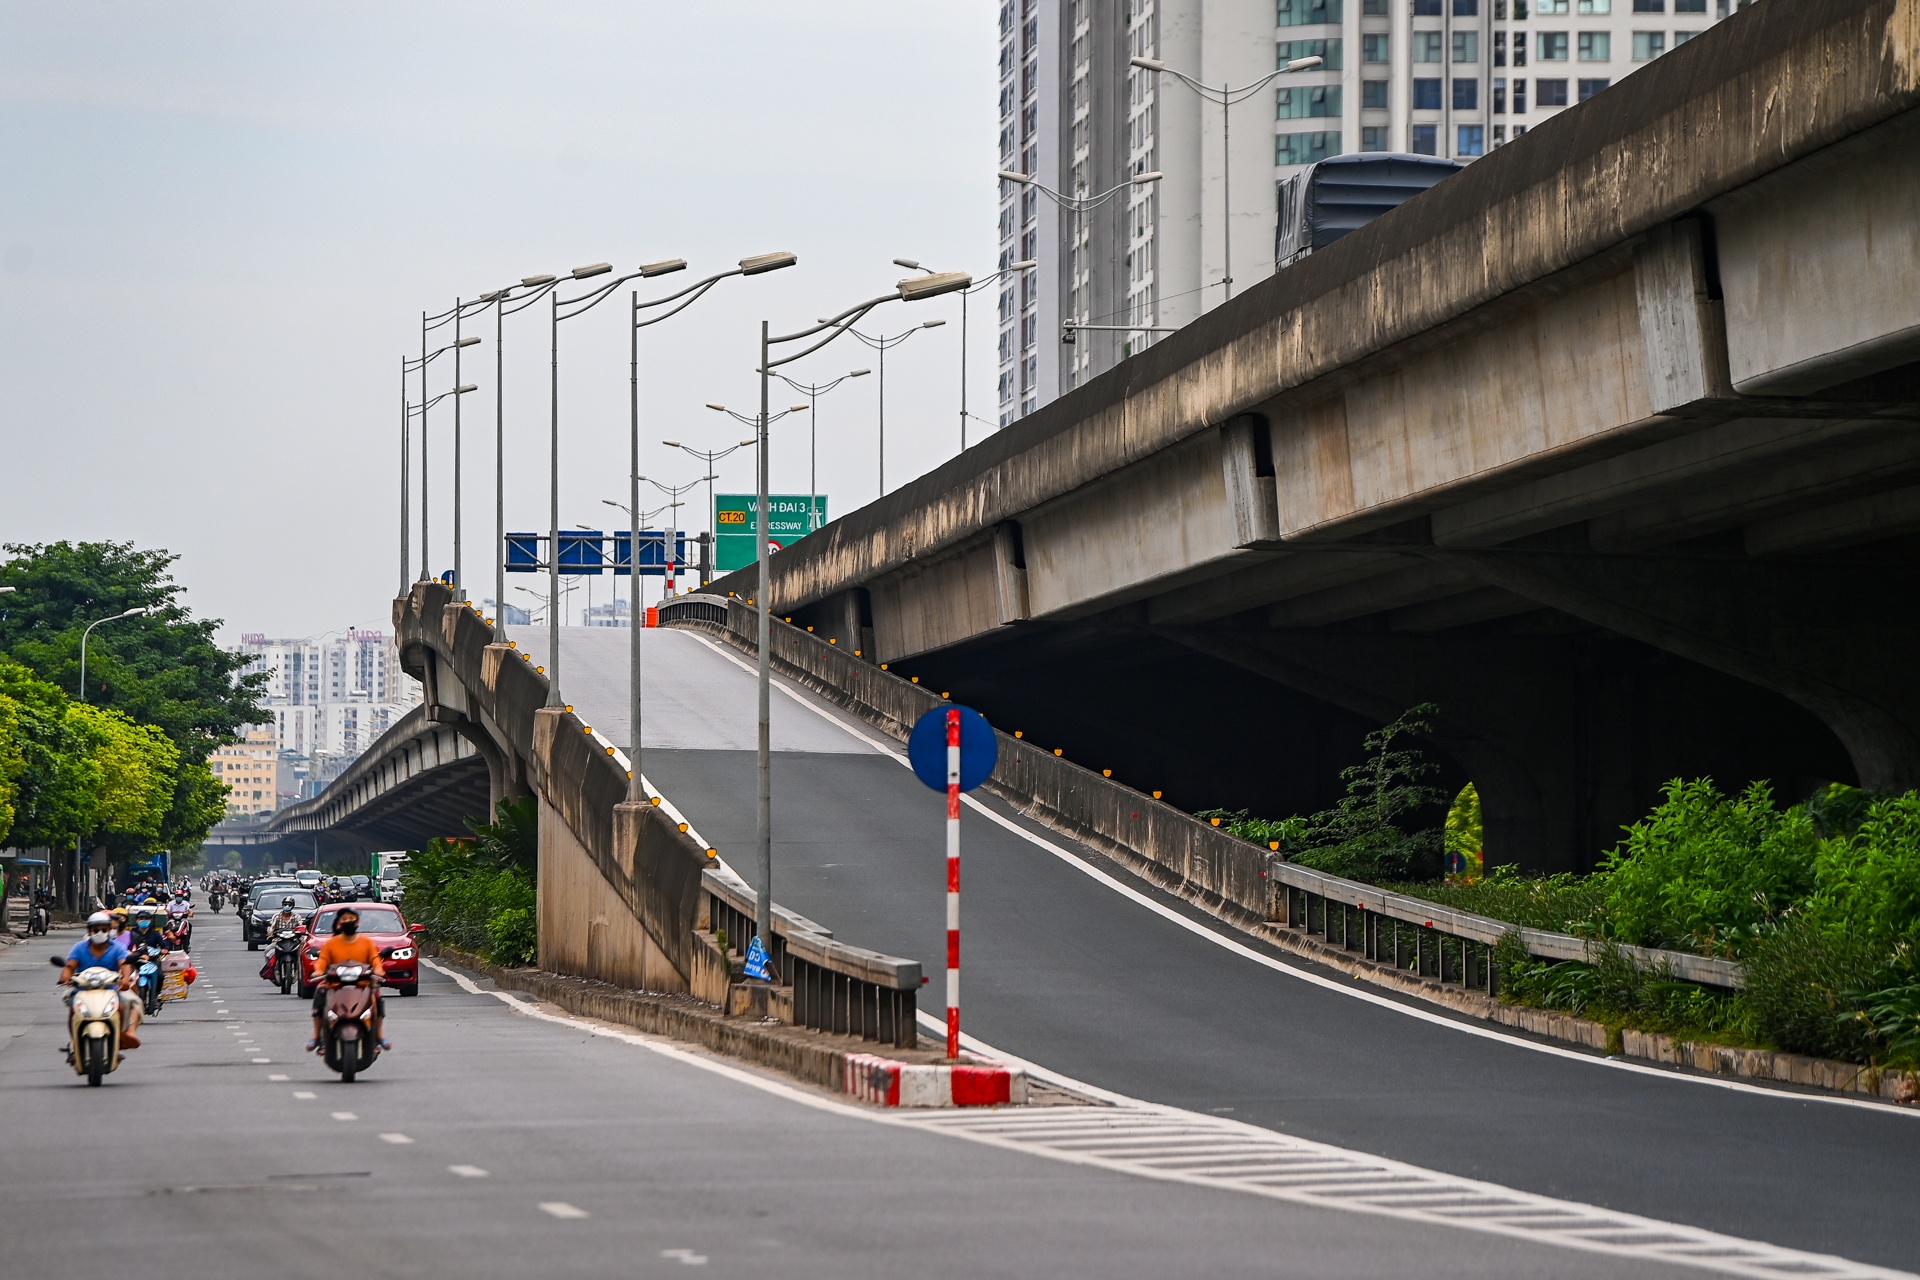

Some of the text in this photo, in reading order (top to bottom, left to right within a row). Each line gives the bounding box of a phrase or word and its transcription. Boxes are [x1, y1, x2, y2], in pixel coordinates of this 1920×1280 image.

[779, 502, 797, 512] ĐAI
[799, 502, 806, 512] 3
[719, 512, 745, 522] CT.20
[750, 521, 802, 530] ERESSWAY
